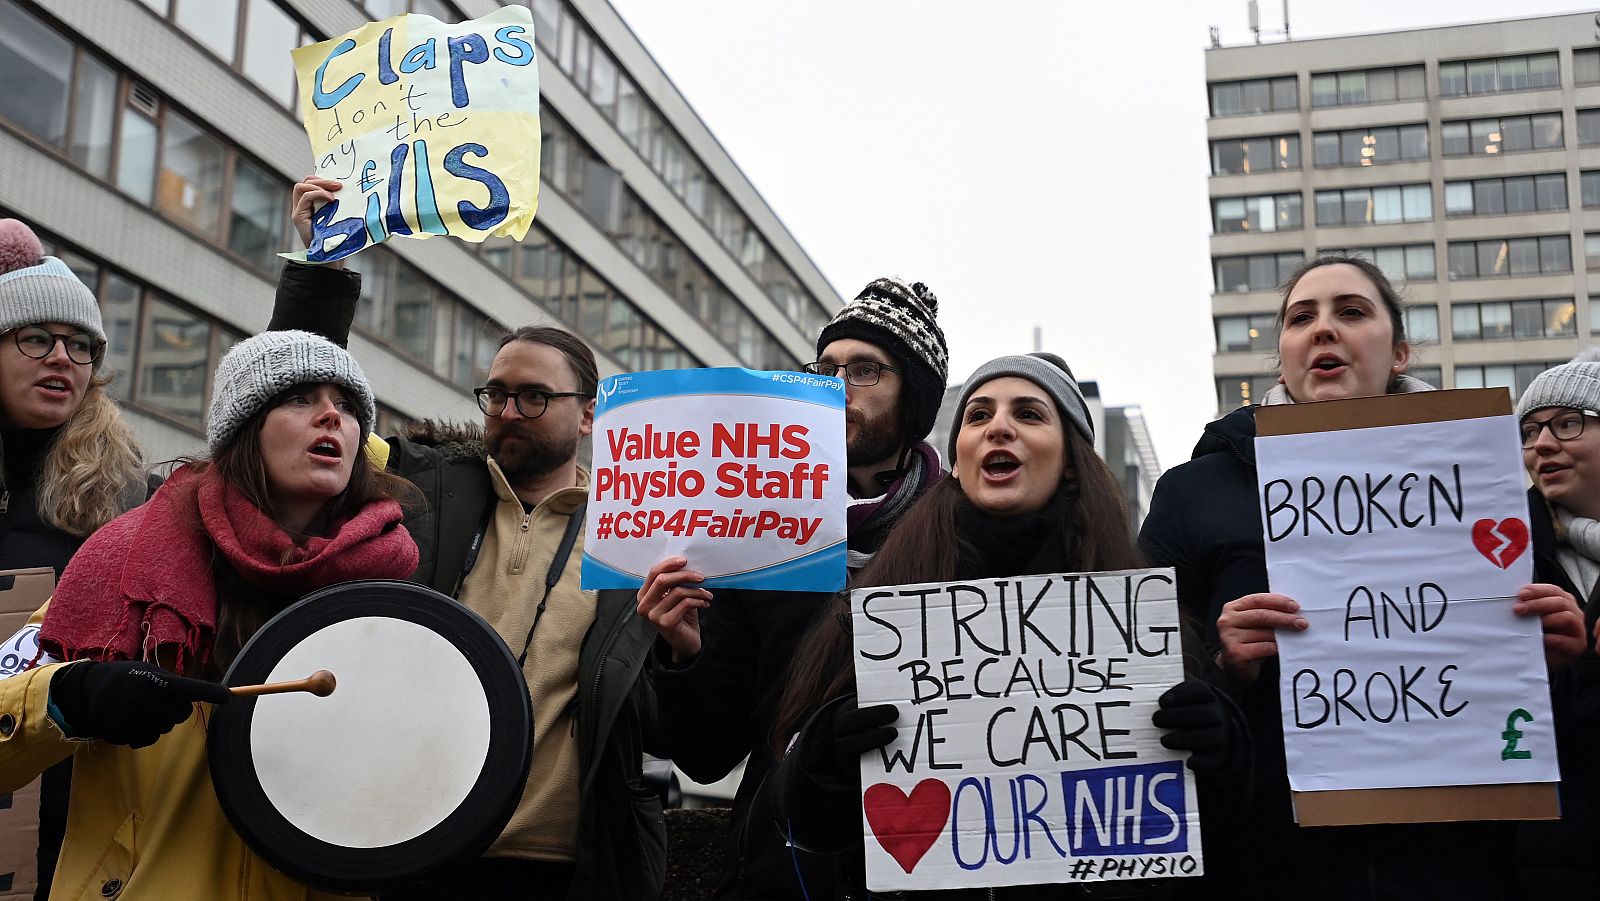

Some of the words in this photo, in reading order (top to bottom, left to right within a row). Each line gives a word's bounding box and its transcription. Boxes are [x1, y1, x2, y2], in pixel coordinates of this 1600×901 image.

[312, 25, 535, 110] Claps
[327, 84, 427, 141] don't
[313, 139, 357, 179] ay
[386, 112, 468, 140] the
[772, 373, 844, 391] #CSP4FairPay
[606, 423, 702, 463] Value
[711, 422, 811, 460] NHS
[595, 461, 706, 507] Physio
[714, 461, 829, 500] Staff
[1263, 464, 1464, 542] BROKEN
[596, 508, 823, 545] #CSP4FairPay
[859, 574, 1179, 661] STRIKING
[1344, 582, 1449, 642] AND
[898, 657, 1134, 706] BECAUSE
[1292, 664, 1469, 729] BROKE
[879, 708, 963, 774] WE
[986, 701, 1138, 768] CARE
[951, 774, 1067, 871] OUR
[1072, 772, 1180, 850] NHS
[1068, 855, 1197, 880] #PHYSIO
